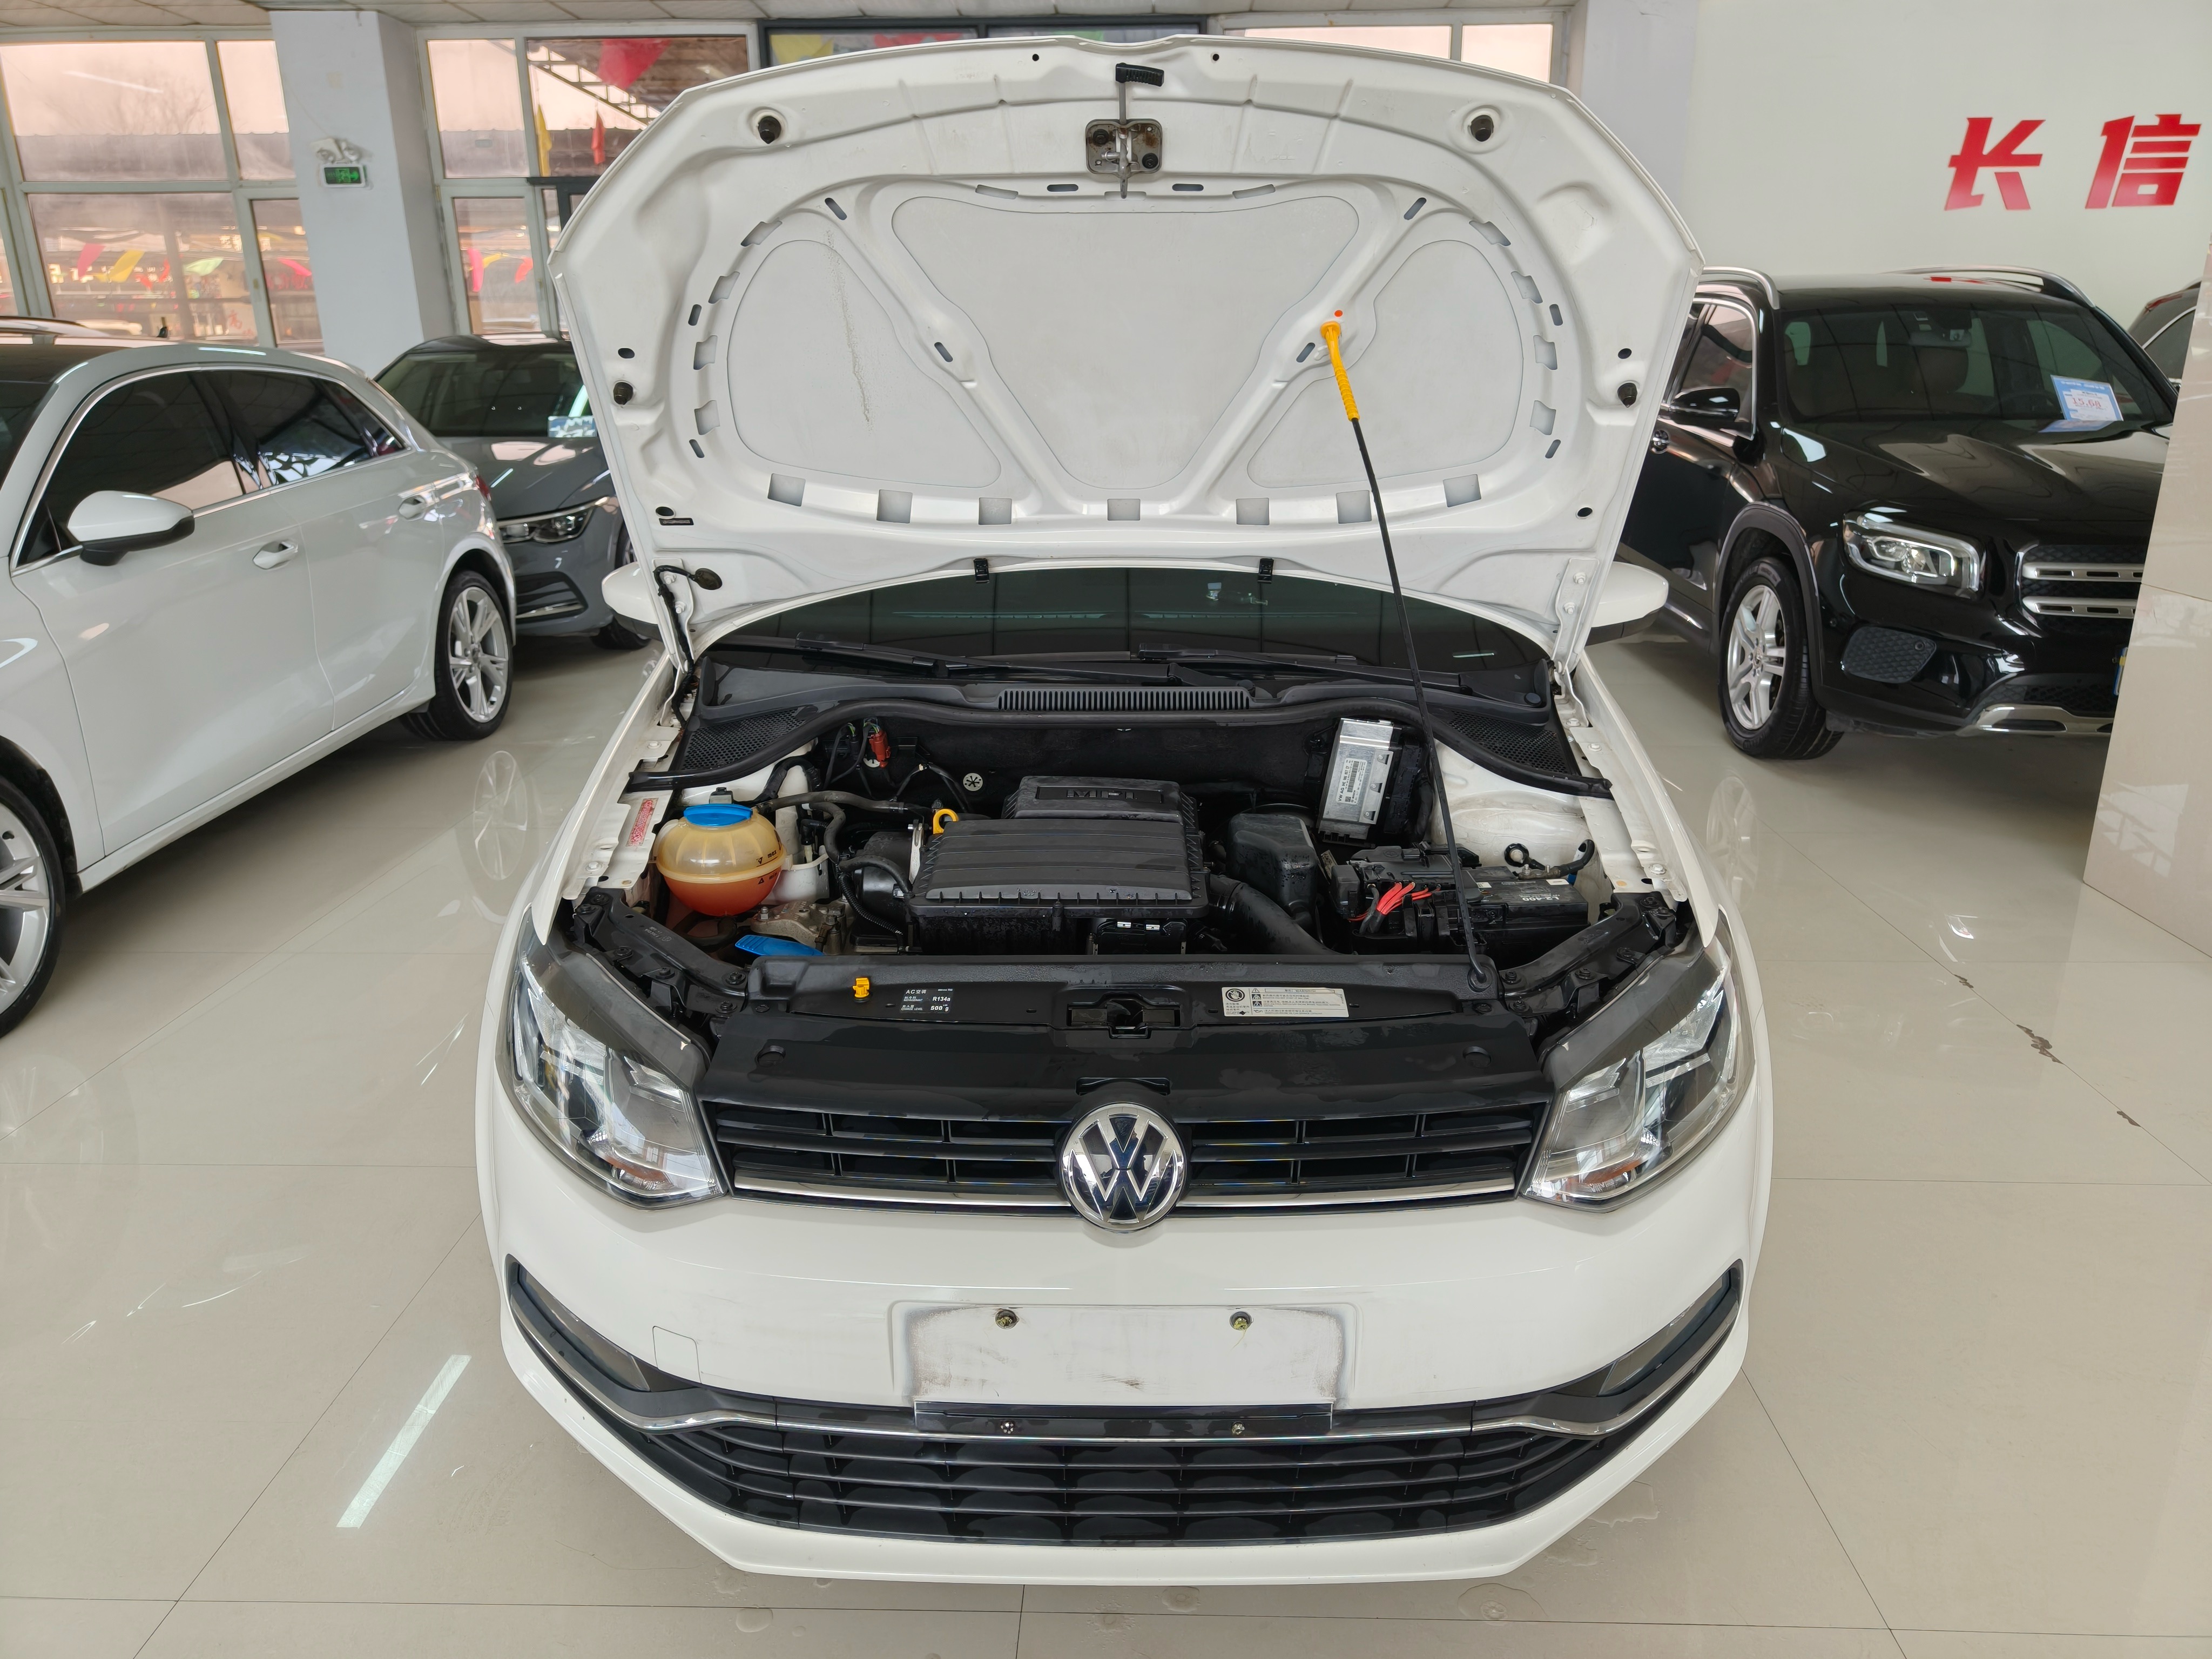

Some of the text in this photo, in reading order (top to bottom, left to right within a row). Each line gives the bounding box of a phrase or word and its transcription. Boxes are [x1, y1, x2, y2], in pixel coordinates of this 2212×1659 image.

[1944, 113, 2202, 211] 长信
[1067, 790, 1134, 799] MPI
[1338, 794, 1343, 802] VW
